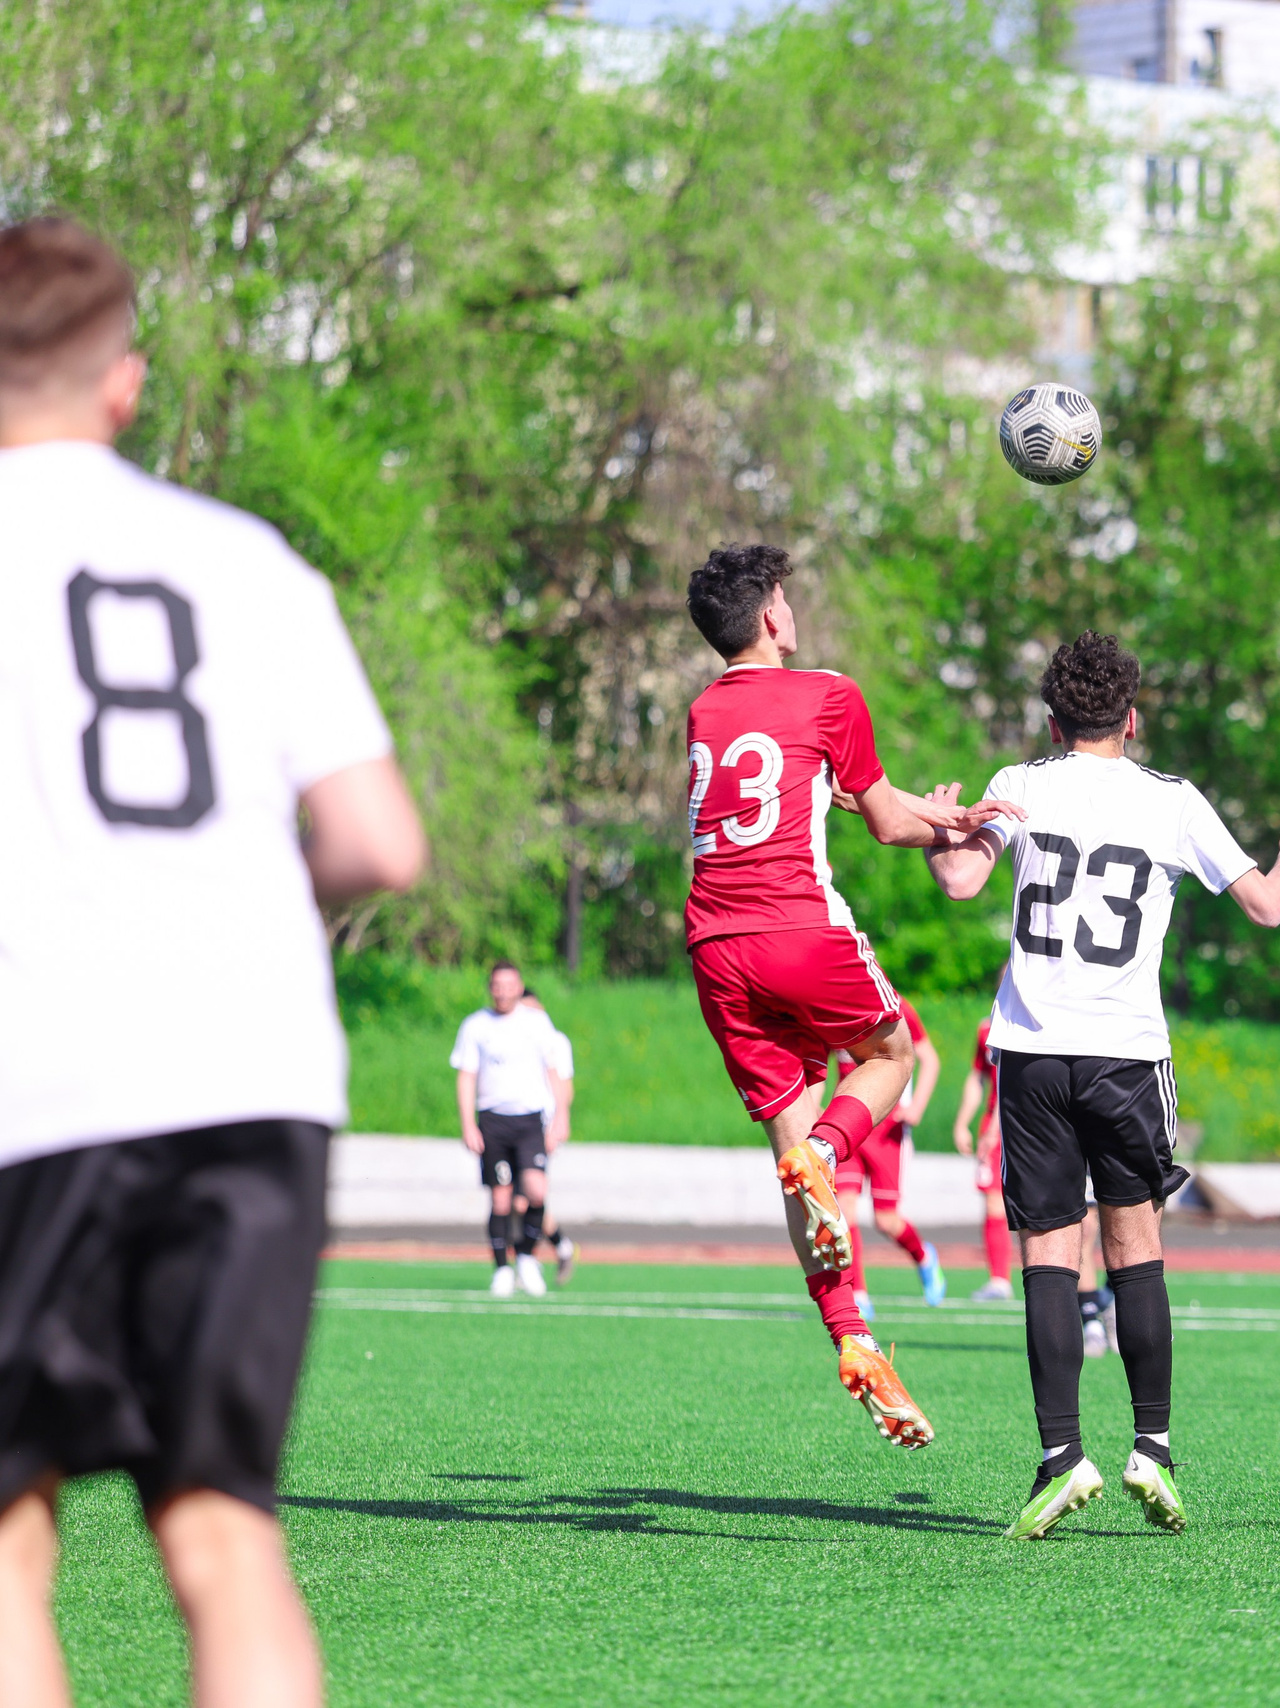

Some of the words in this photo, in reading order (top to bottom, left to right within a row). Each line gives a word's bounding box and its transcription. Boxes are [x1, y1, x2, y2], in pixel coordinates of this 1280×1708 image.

[66, 569, 216, 829] 8
[688, 731, 784, 858] 23
[1015, 831, 1153, 968] 23
